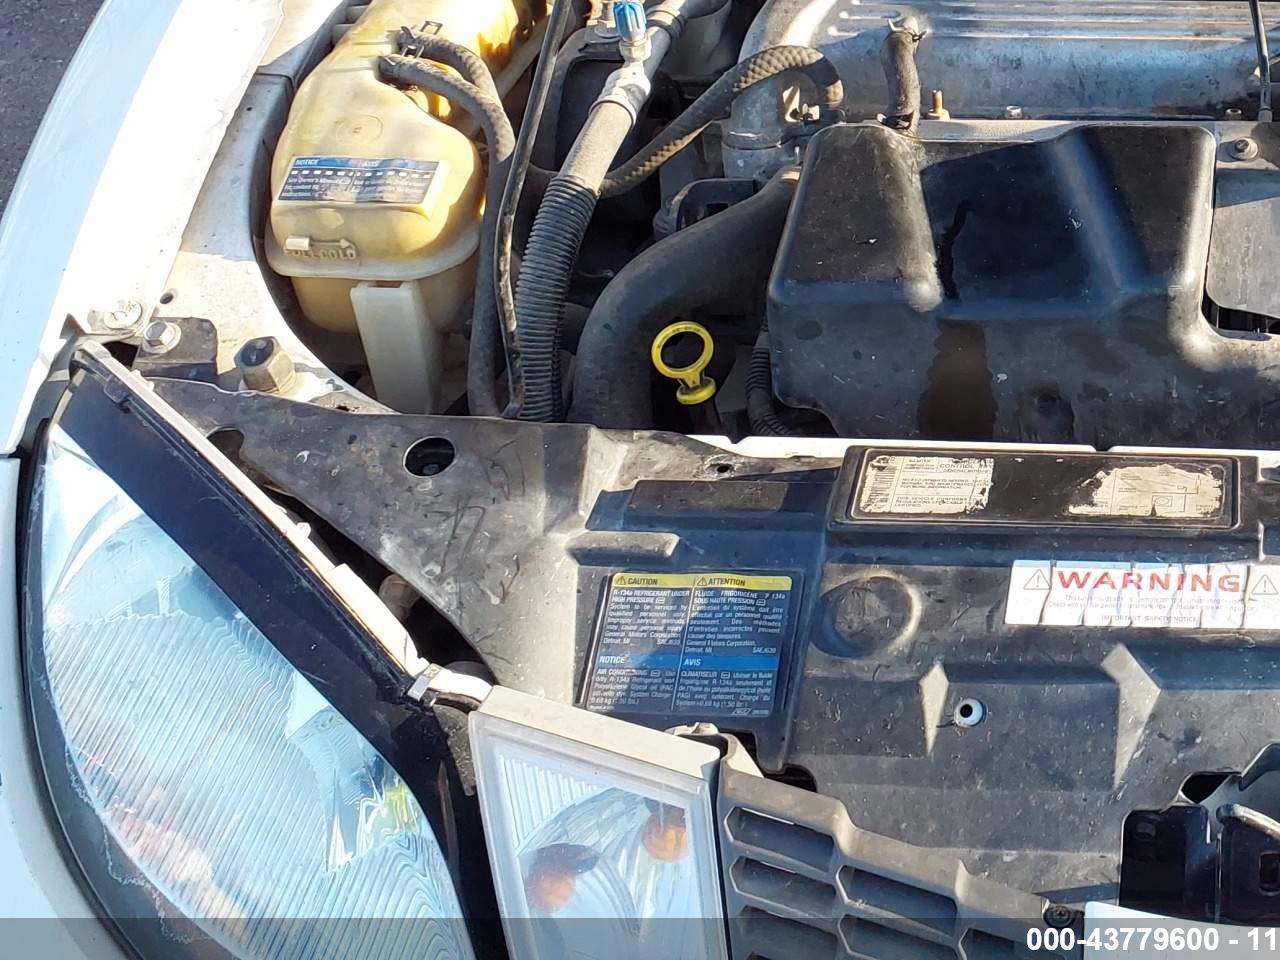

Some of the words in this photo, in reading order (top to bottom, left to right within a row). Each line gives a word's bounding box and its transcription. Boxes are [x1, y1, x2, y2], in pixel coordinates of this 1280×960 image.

[627, 577, 658, 585] CAUTION
[708, 577, 746, 586] ATTENTION
[1057, 570, 1241, 593] WARNING
[599, 655, 625, 664] NOTICE
[683, 658, 701, 666] AVIS
